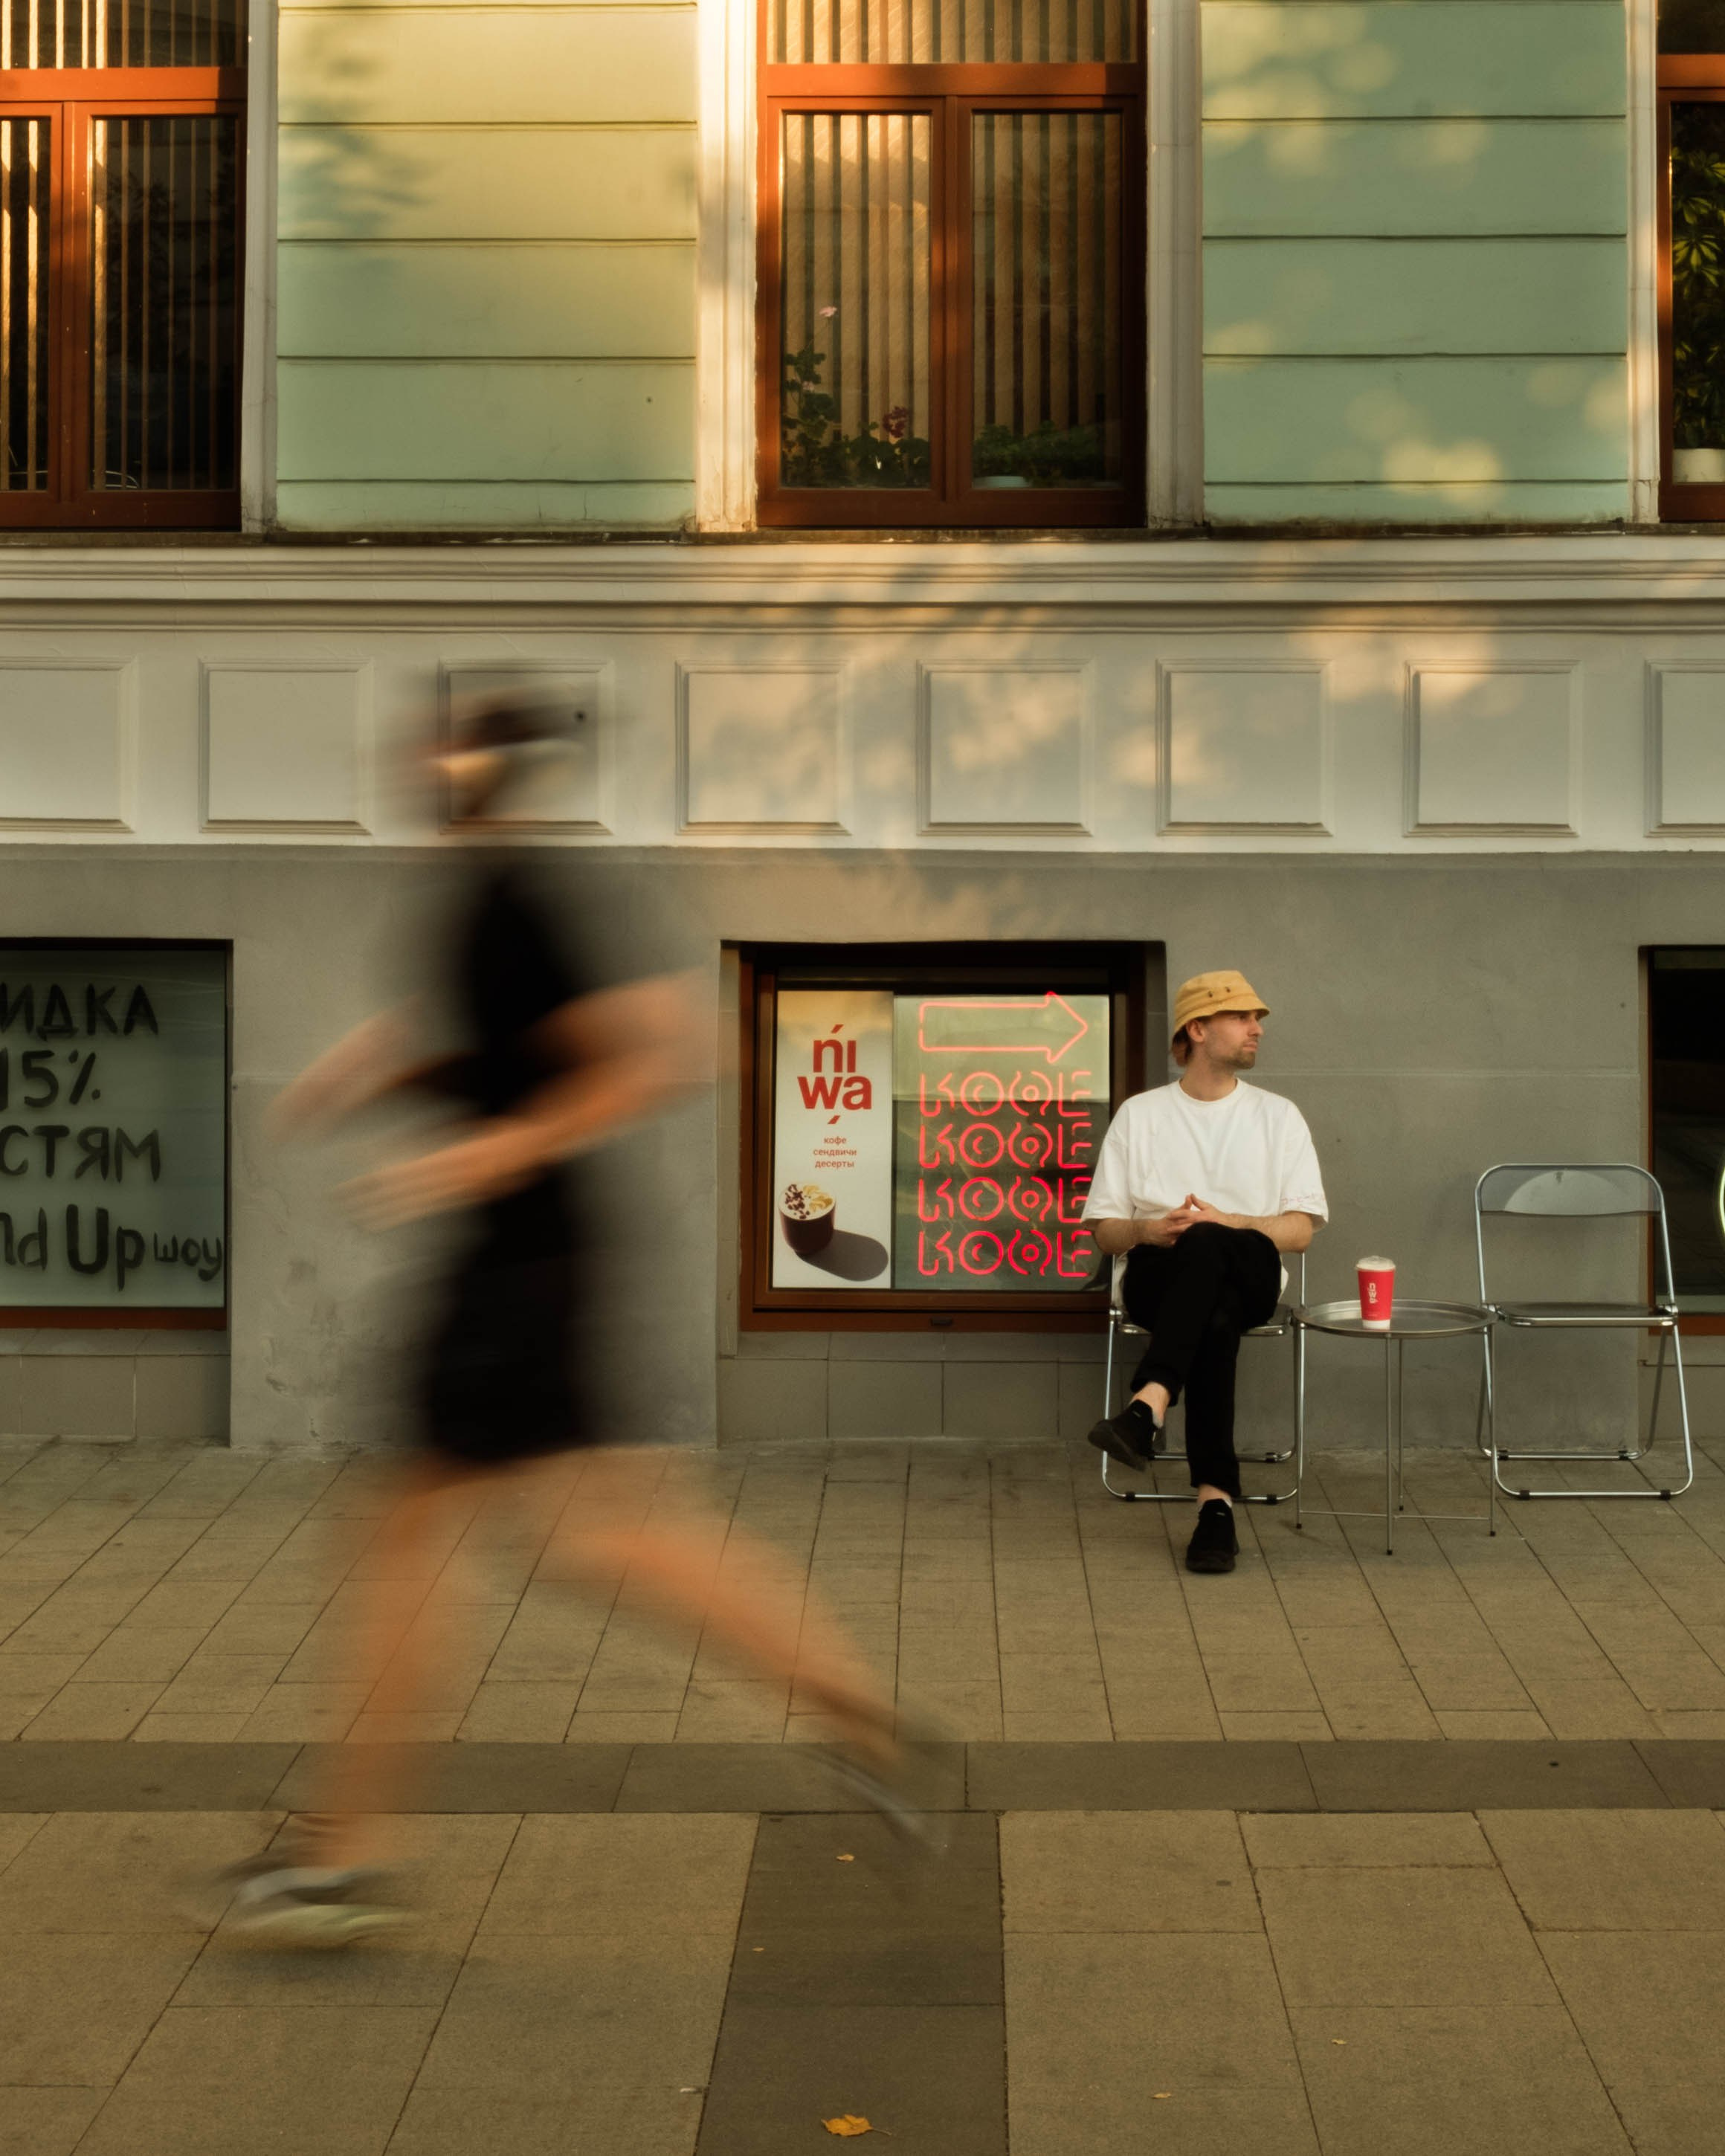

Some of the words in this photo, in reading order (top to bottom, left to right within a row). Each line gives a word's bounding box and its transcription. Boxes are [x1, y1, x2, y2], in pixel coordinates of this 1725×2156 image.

[0, 981, 158, 1041] ИДКА
[0, 1125, 161, 1183] СТЯМ
[815, 1161, 854, 1169] десерты
[824, 1136, 846, 1146] кофе
[153, 1232, 222, 1281] шоу
